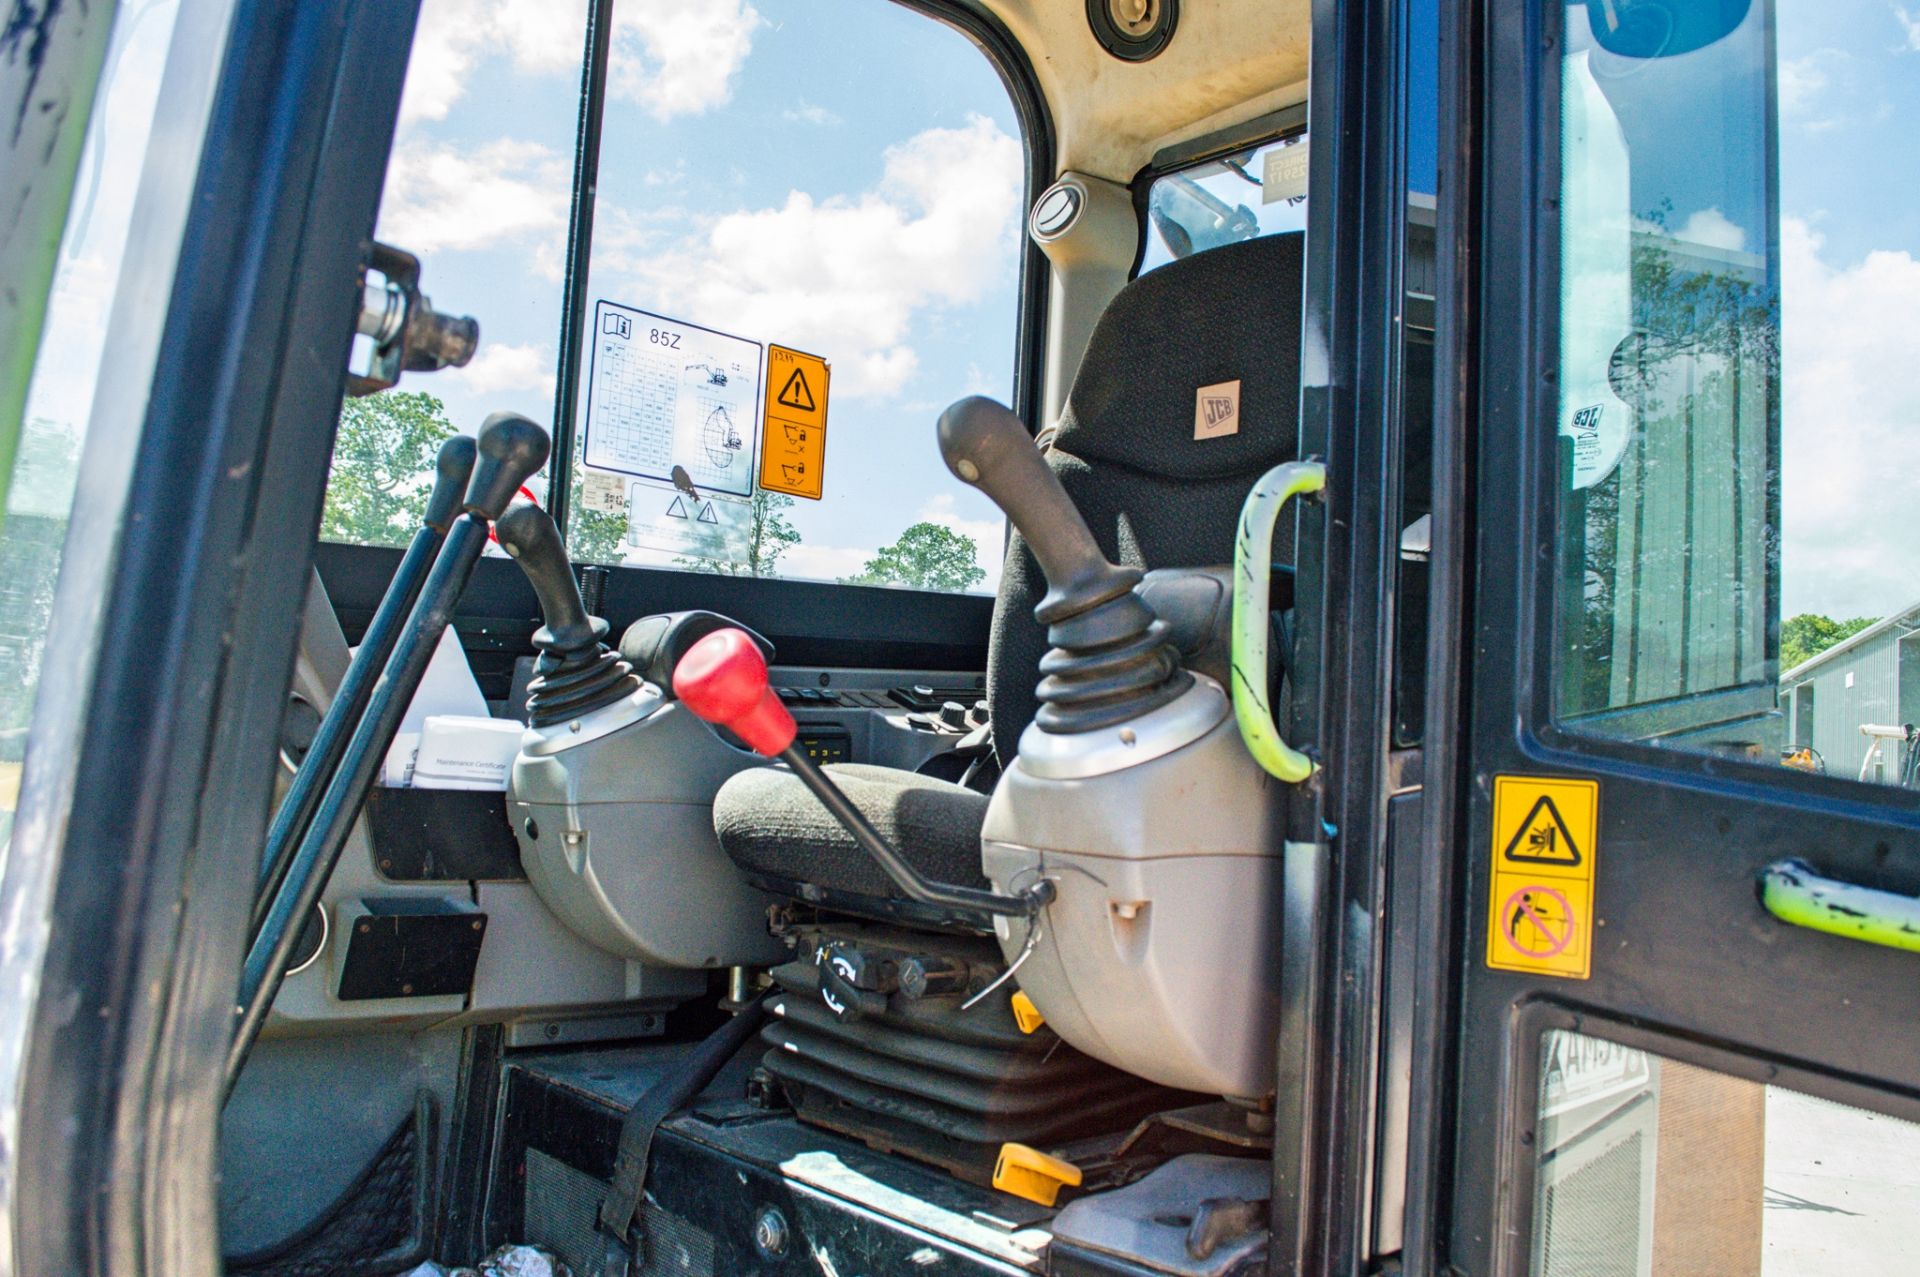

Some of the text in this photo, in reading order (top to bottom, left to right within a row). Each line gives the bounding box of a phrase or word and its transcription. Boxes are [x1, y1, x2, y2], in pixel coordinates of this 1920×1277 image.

[650, 328, 681, 350] 85Z
[1207, 399, 1232, 425] JCB
[437, 758, 506, 769] Maintenance Certificate
